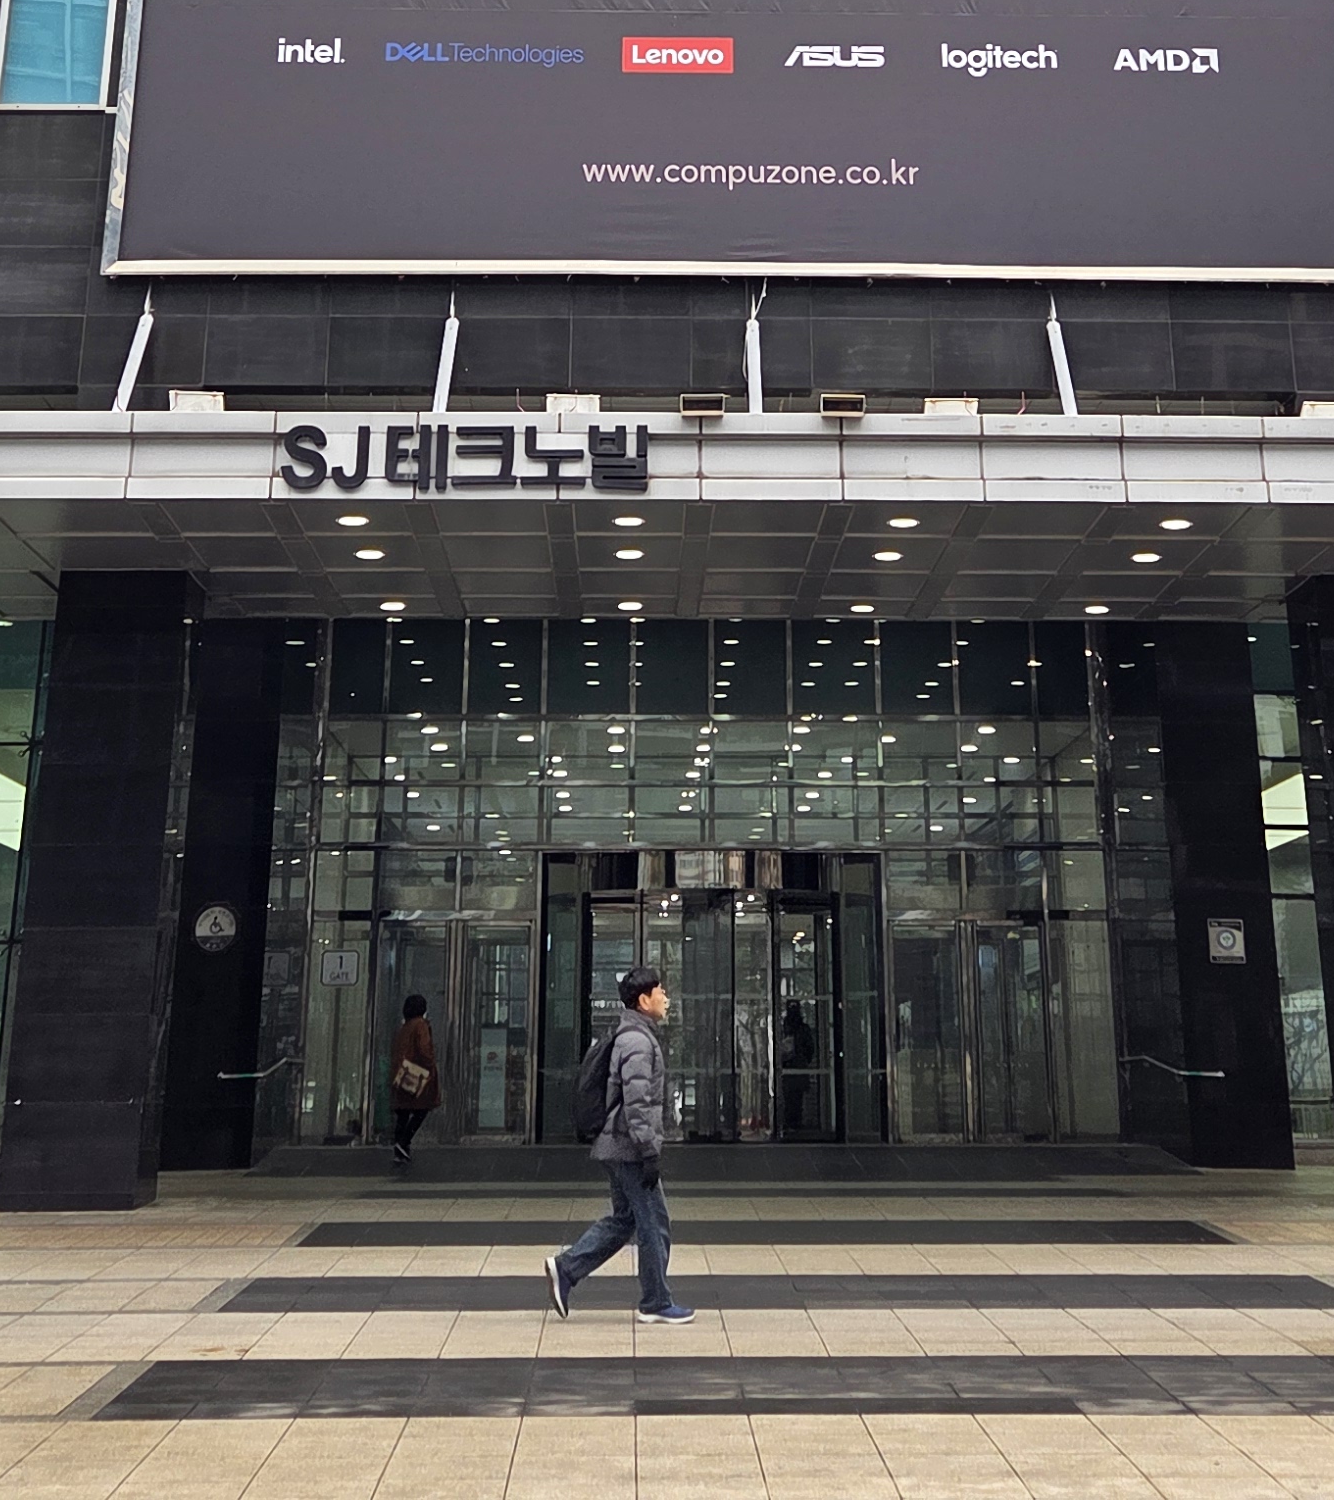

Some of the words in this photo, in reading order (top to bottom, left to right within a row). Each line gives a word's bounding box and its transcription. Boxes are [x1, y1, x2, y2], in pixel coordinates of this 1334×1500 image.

[631, 44, 725, 66] Lenovo
[784, 45, 885, 68] ASUS
[941, 43, 1058, 77] logitech
[1113, 49, 1190, 73] AMD
[582, 159, 920, 190] www.compuzone.co.kr
[338, 955, 344, 970] 1
